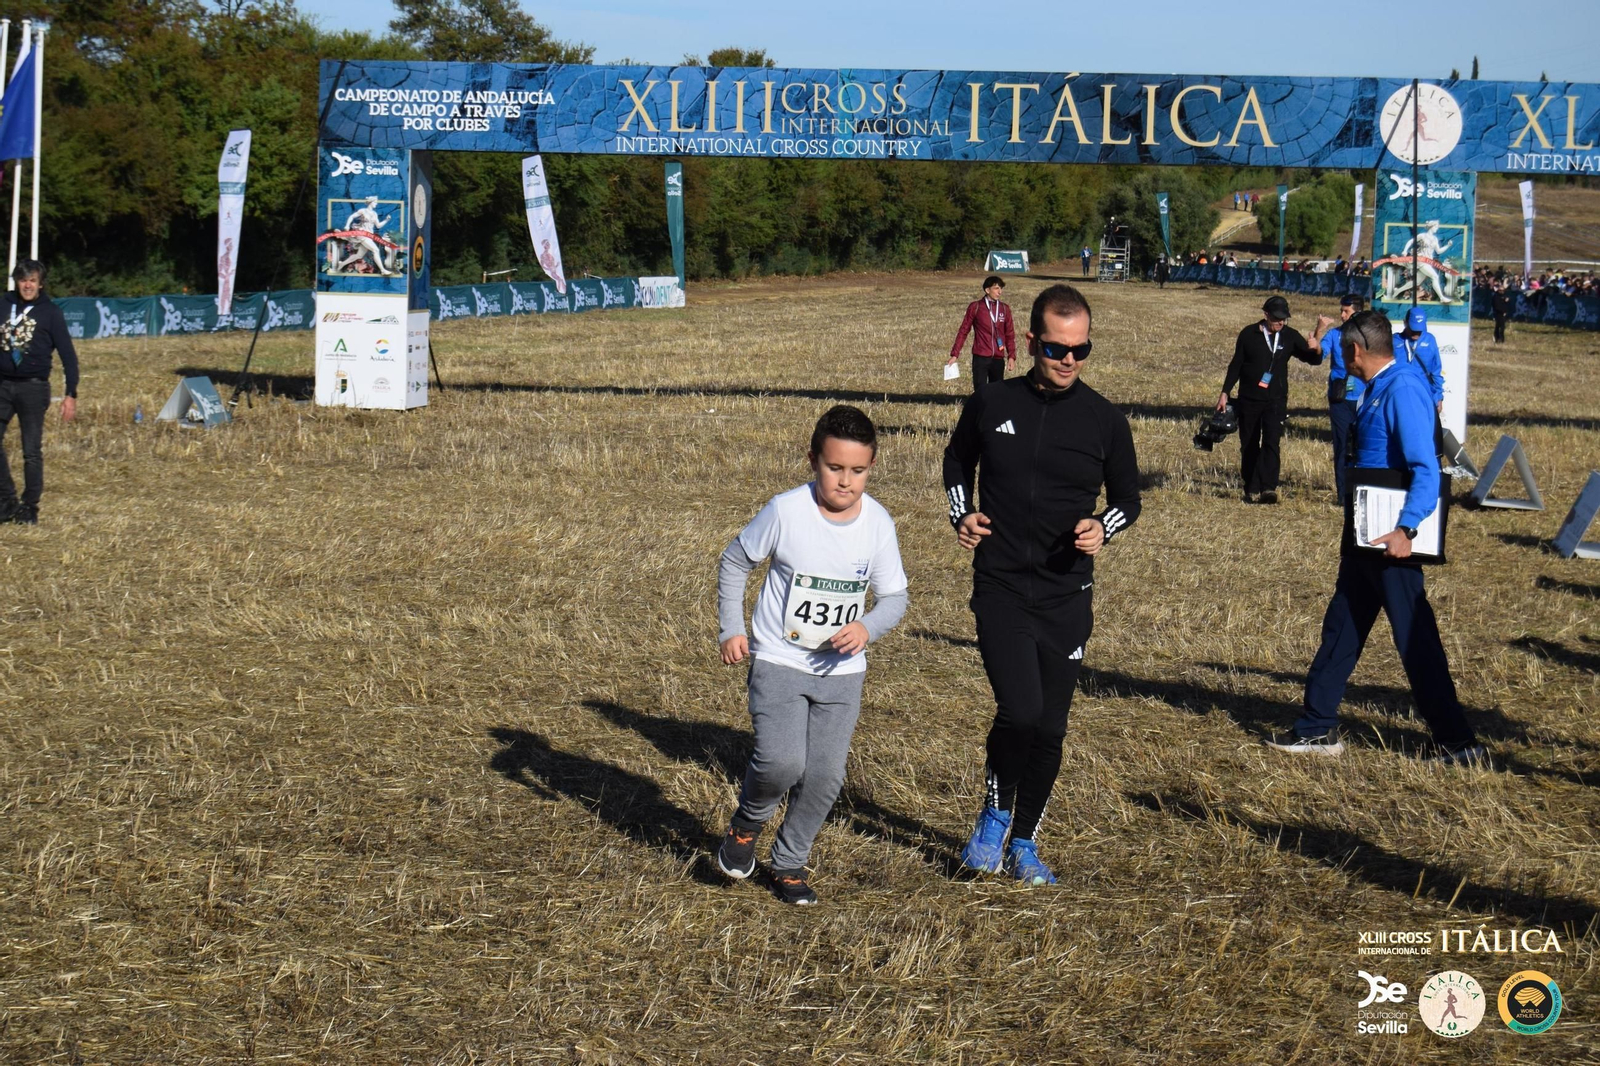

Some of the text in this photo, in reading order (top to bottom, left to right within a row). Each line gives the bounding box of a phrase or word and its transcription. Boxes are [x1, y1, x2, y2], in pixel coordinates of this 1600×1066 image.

[335, 88, 555, 105] CAMPEONATO DE ANDALUCÍA
[369, 102, 521, 118] DE CAMPO A TRAVÉS
[616, 79, 907, 134] XLIII CROSS
[965, 71, 1279, 149] ITÁLICA
[403, 117, 490, 131] POR CLUBES
[781, 117, 954, 137] INTERNACIONAL
[1507, 93, 1594, 151] XL
[616, 137, 922, 156] INTERNATIONAL CROSS COUNTRY
[365, 166, 399, 176] Sevilla
[1427, 181, 1463, 189] Diputación
[1427, 189, 1463, 199] Sevilla
[284, 311, 303, 326] Sevilla
[816, 580, 854, 592] ITÁLICA
[794, 600, 859, 627] 4310
